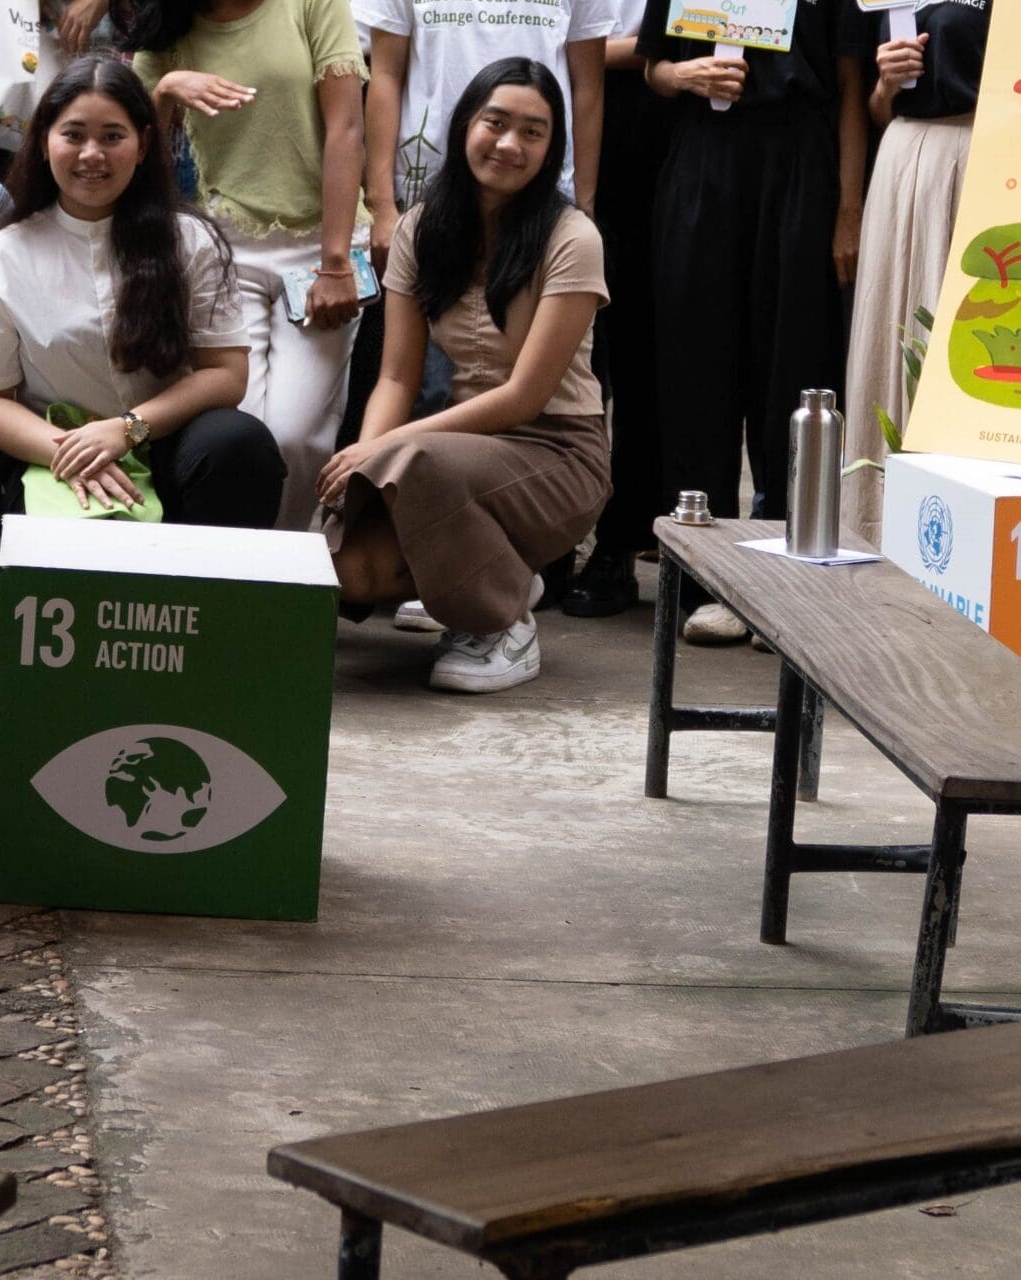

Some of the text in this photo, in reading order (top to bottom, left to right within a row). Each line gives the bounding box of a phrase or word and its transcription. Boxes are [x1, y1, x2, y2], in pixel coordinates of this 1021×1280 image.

[423, 10, 556, 28] Change Conference
[720, 0, 747, 17] Out
[9, 8, 41, 33] Was
[978, 430, 1021, 445] SUSTAI
[14, 595, 200, 668] 13 CLIMATE
[94, 640, 185, 673] ACTION
